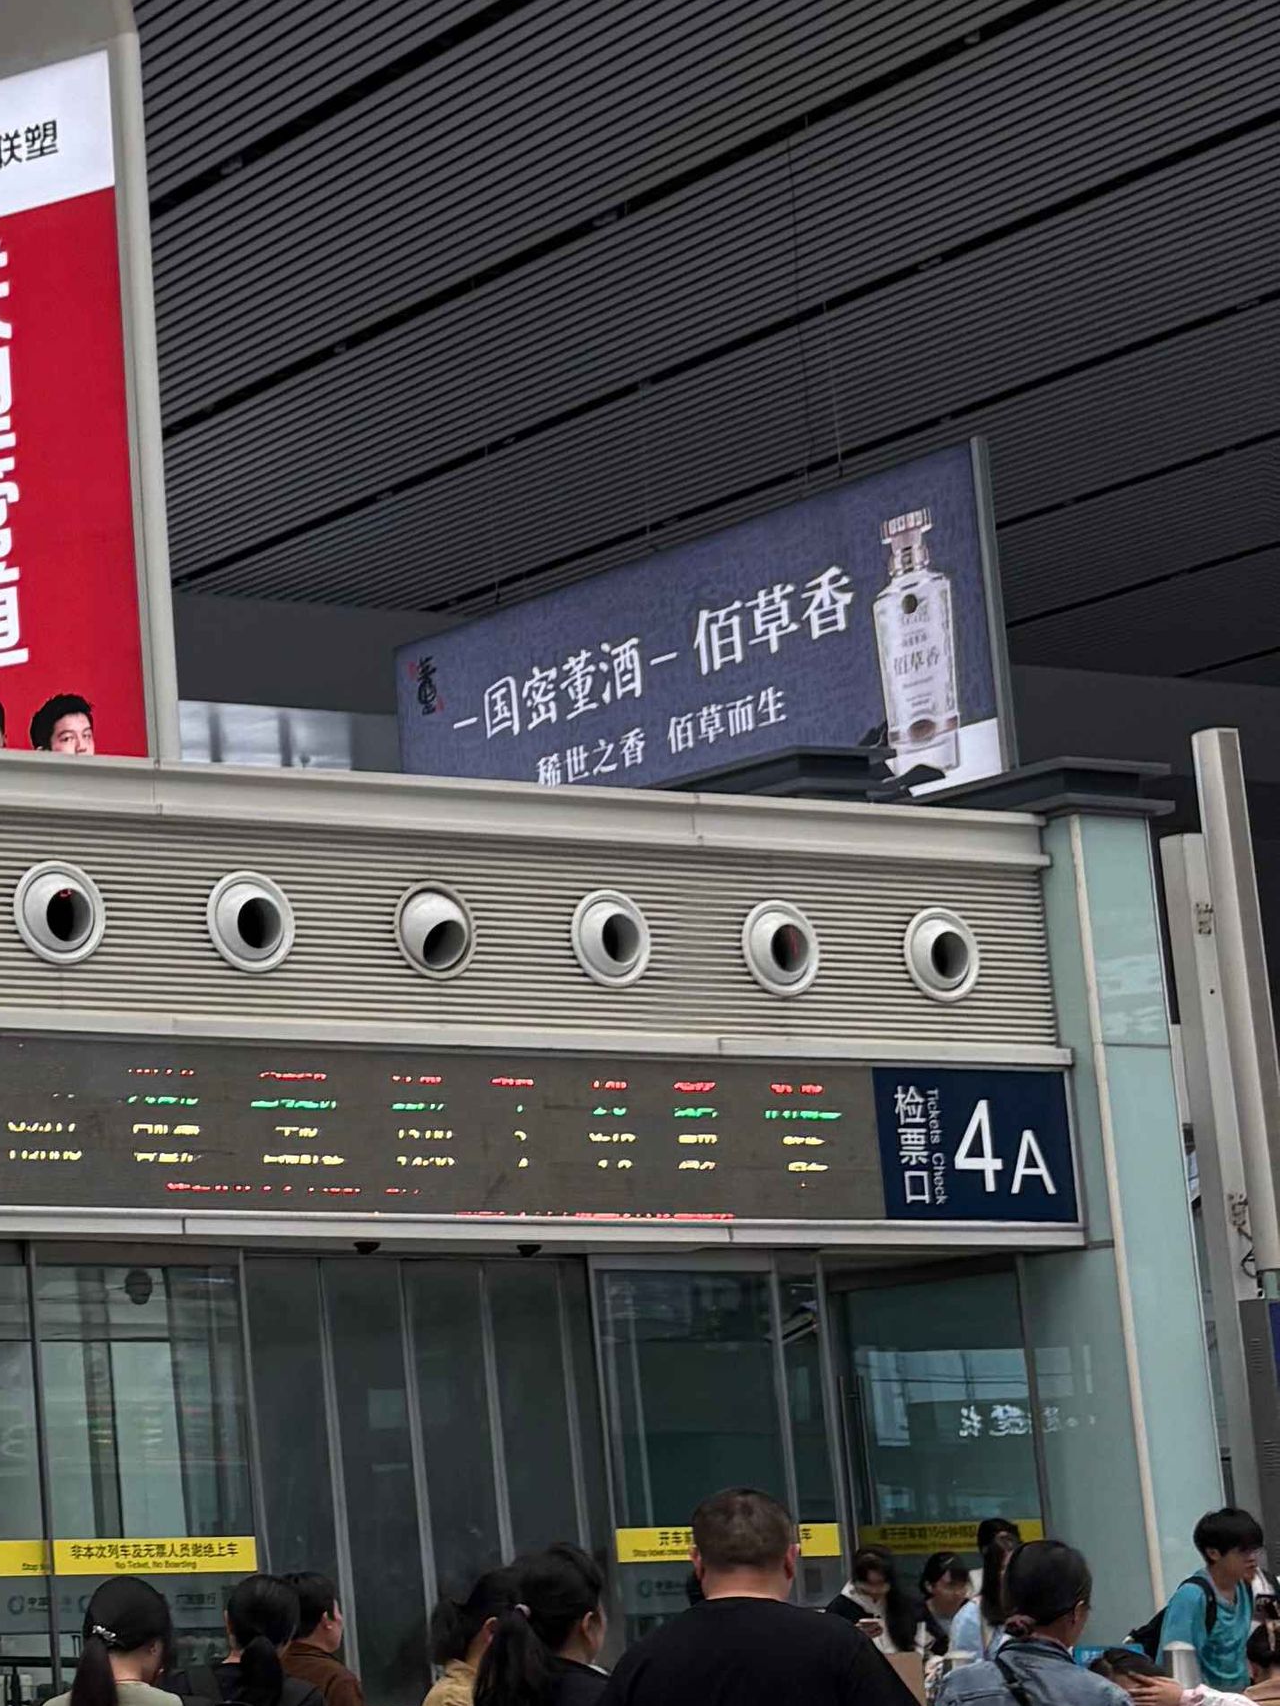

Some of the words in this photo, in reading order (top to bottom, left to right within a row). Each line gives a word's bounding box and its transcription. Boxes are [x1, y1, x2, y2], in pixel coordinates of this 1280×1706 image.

[483, 636, 642, 739] 国密董酒
[693, 565, 855, 676] 佰草香
[667, 686, 787, 754] 佰草而生
[893, 1085, 931, 1204] 检票口
[926, 1087, 942, 1144] Tickets
[953, 1098, 1057, 1196] 4A
[931, 1152, 949, 1206] Check
